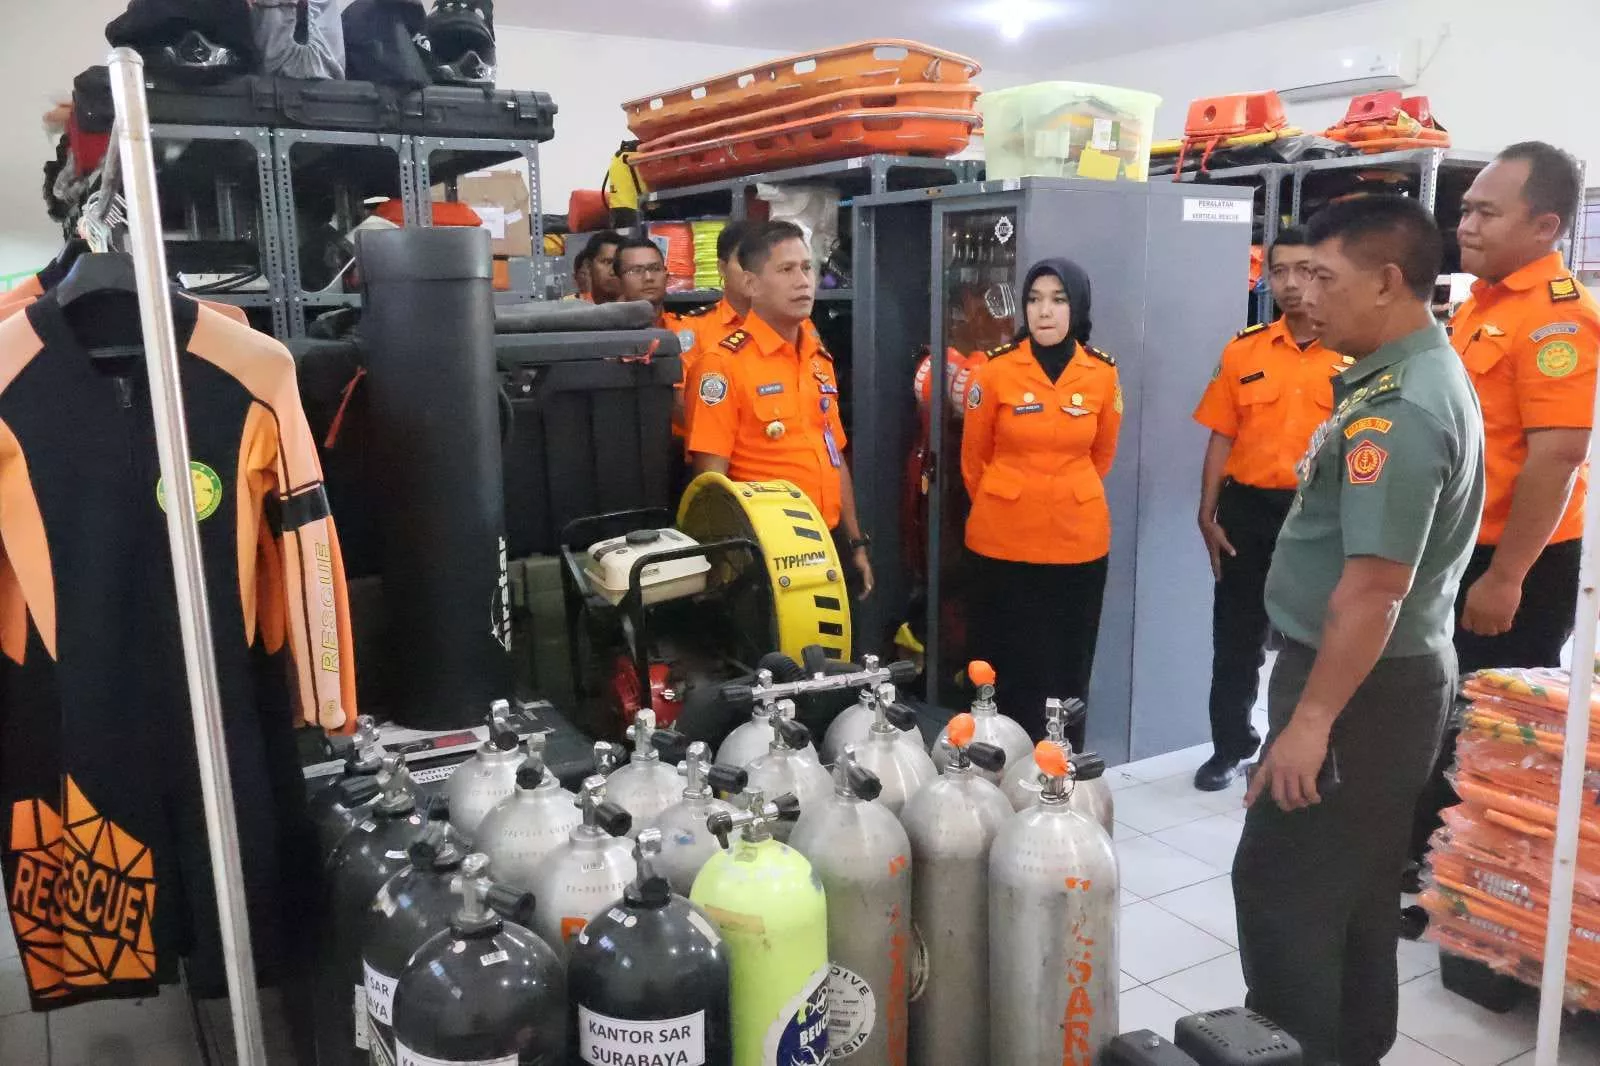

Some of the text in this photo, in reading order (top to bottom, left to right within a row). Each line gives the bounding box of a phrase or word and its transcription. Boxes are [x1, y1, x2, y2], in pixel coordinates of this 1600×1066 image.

[1198, 200, 1234, 209] PERALATAN
[773, 551, 826, 571] TYPHOON
[316, 542, 340, 673] RESCUE
[369, 978, 390, 997] SAR
[830, 966, 869, 996] DIVE
[366, 995, 389, 1020] AYA
[588, 1021, 691, 1044] KANTOR SAR
[591, 1045, 689, 1066] SURABAYA
